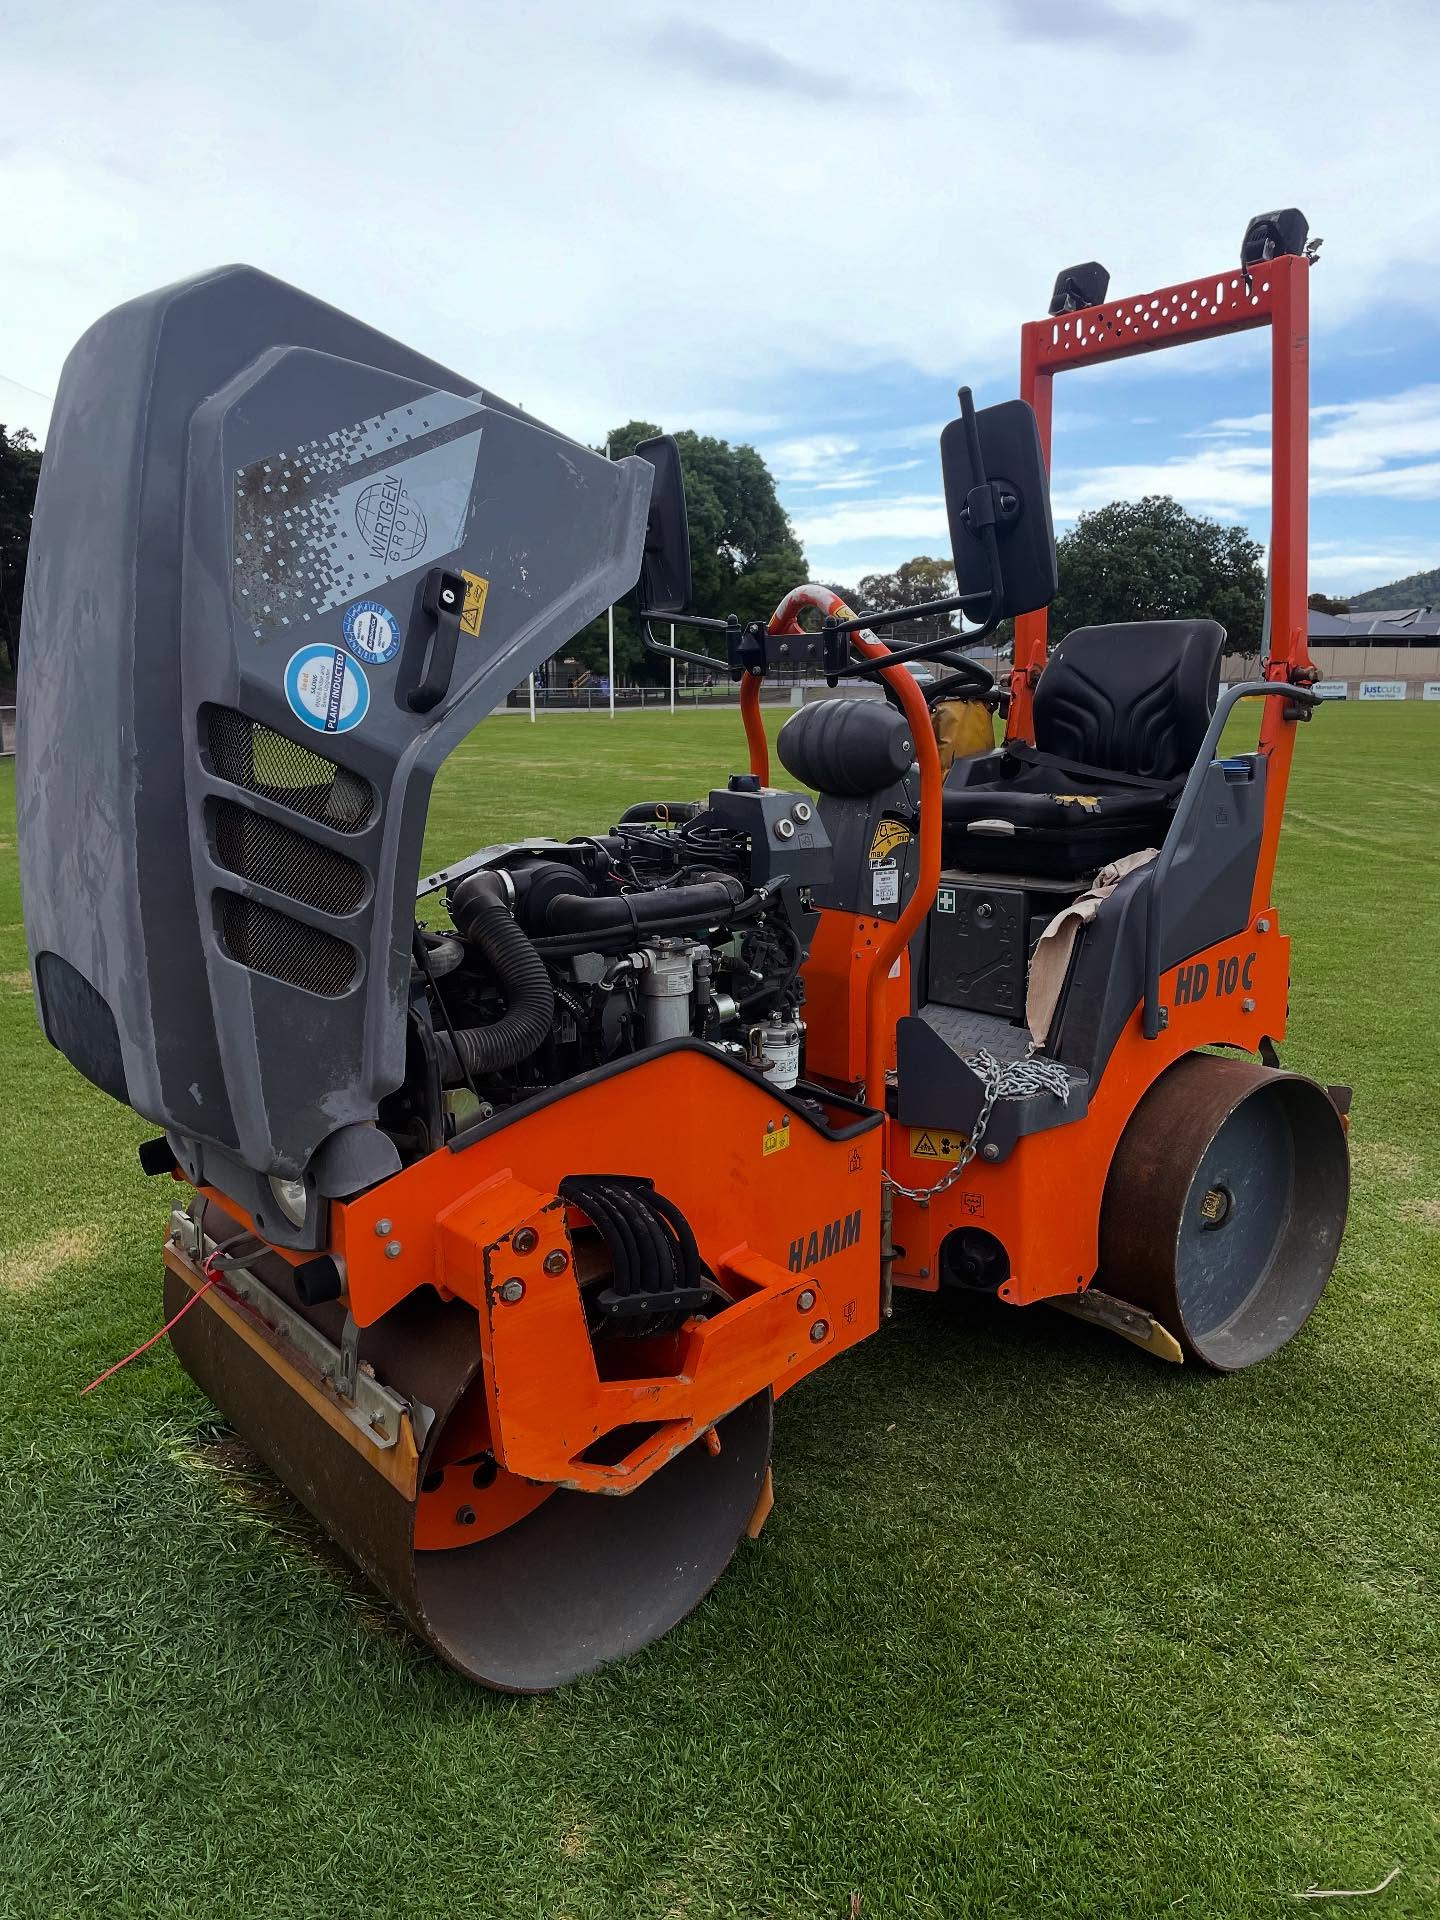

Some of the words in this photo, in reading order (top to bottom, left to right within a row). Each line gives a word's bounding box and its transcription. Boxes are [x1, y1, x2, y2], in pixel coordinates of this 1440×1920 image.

[369, 475, 399, 558] WIRTGEN
[389, 489, 410, 562] GROUP
[332, 653, 344, 699] INDUCTED
[1363, 684, 1401, 696] justcuts
[328, 699, 338, 729] PLANT
[870, 850, 884, 858] max
[1175, 963, 1209, 1006] HD
[1216, 956, 1239, 997] 10
[1242, 952, 1257, 990] C
[788, 1208, 861, 1274] HAMM
